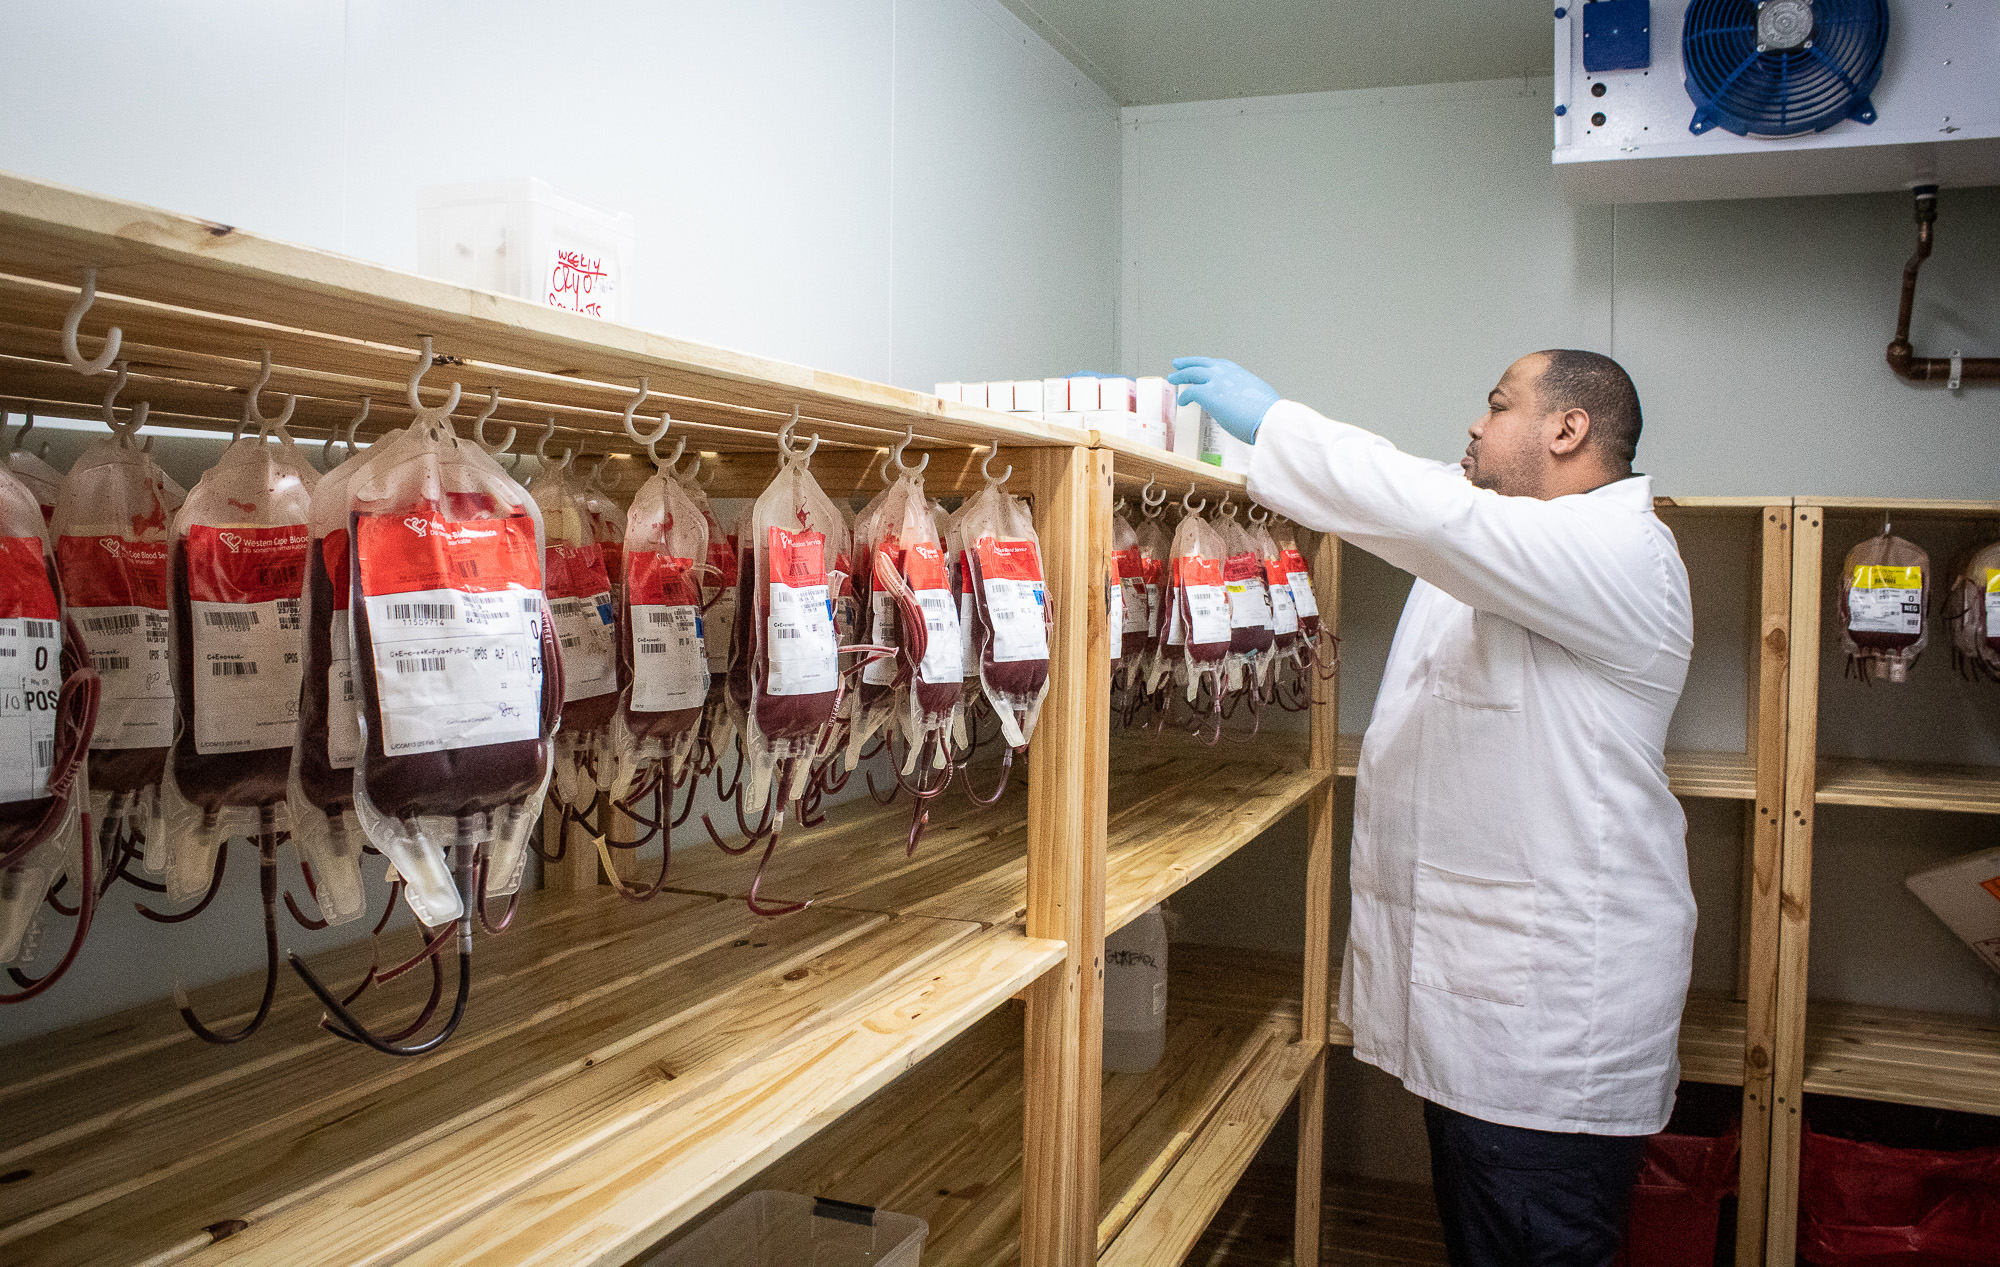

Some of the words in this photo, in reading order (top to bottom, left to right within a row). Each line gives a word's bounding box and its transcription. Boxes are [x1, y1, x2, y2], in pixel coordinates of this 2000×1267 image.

[558, 249, 601, 281] WEEKLY
[552, 266, 593, 310] CRYO
[26, 690, 58, 712] POS
